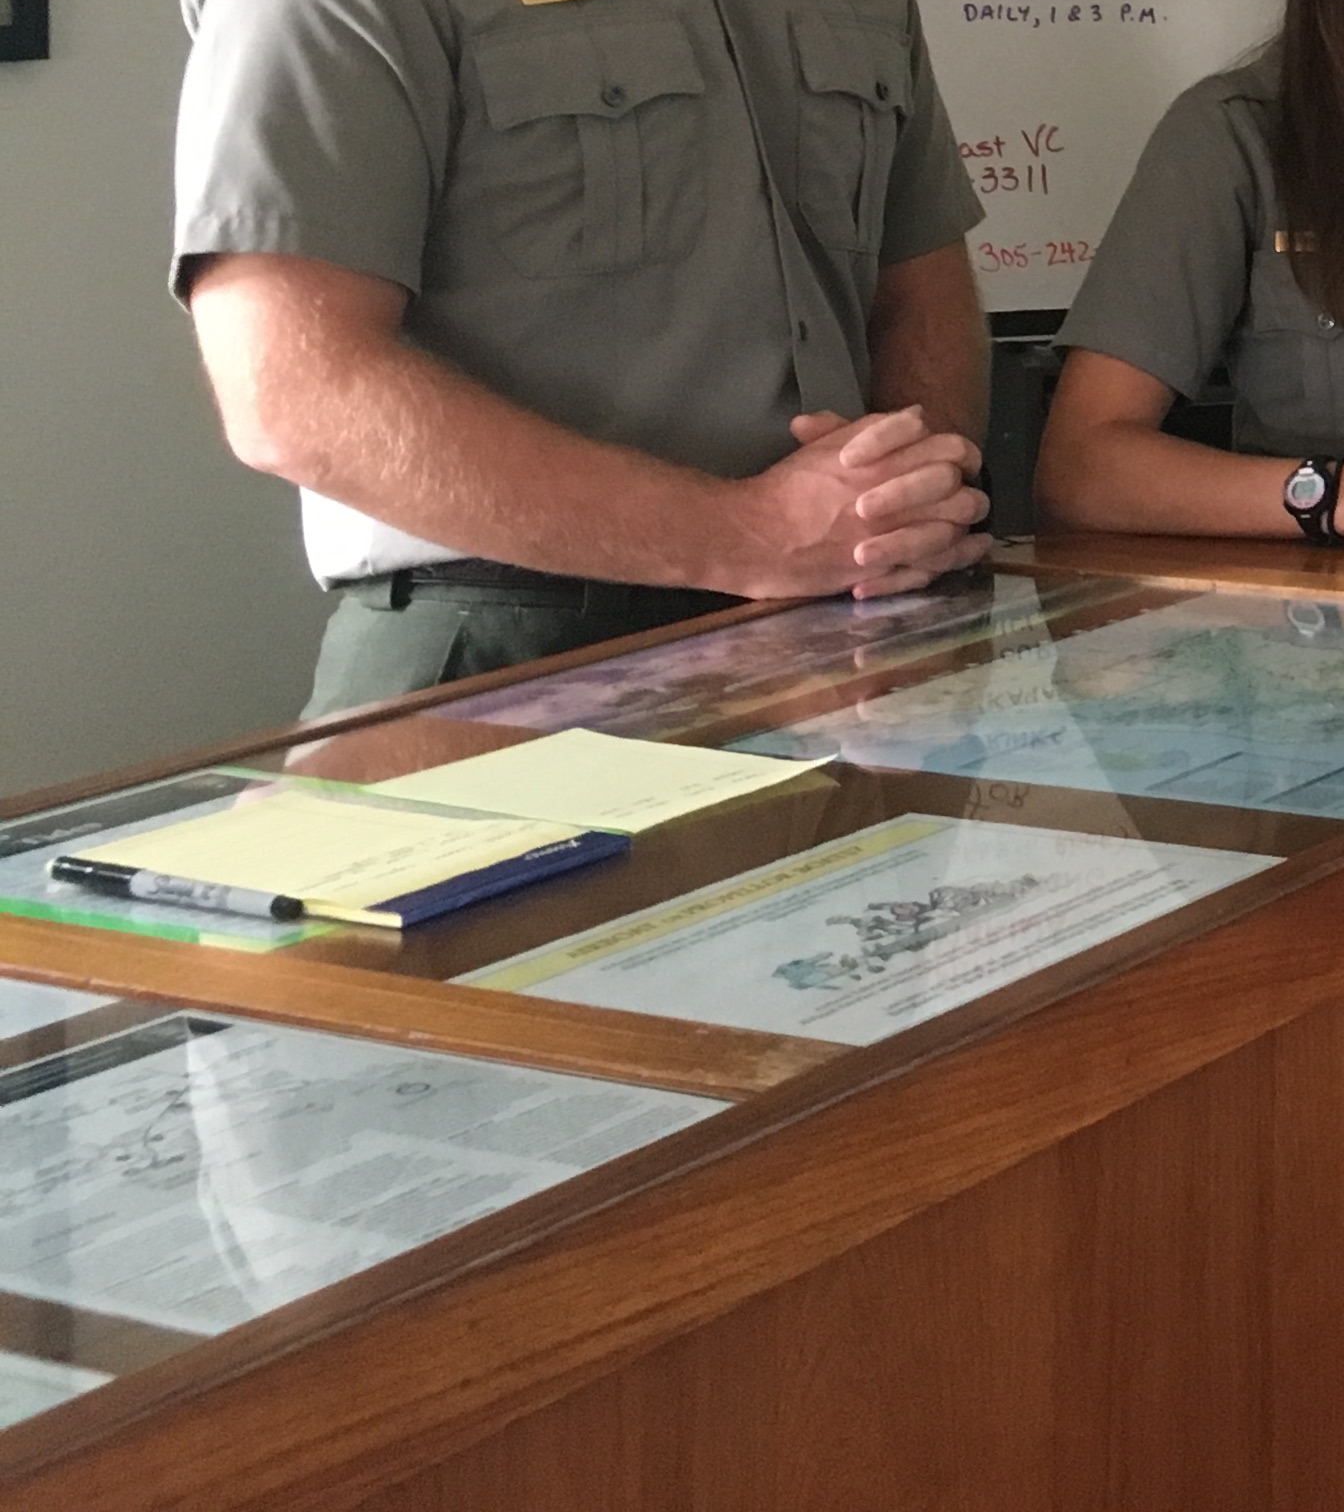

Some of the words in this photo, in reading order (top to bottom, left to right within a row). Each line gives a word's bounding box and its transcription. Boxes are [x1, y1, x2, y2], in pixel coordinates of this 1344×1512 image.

[962, 2, 1042, 29] DAILY,
[1066, 5, 1082, 22] &
[1090, 4, 1103, 22] 3
[958, 133, 1007, 160] ast
[1020, 122, 1066, 159] VC
[971, 163, 1050, 196] -3311
[977, 240, 1098, 274] 305-242-
